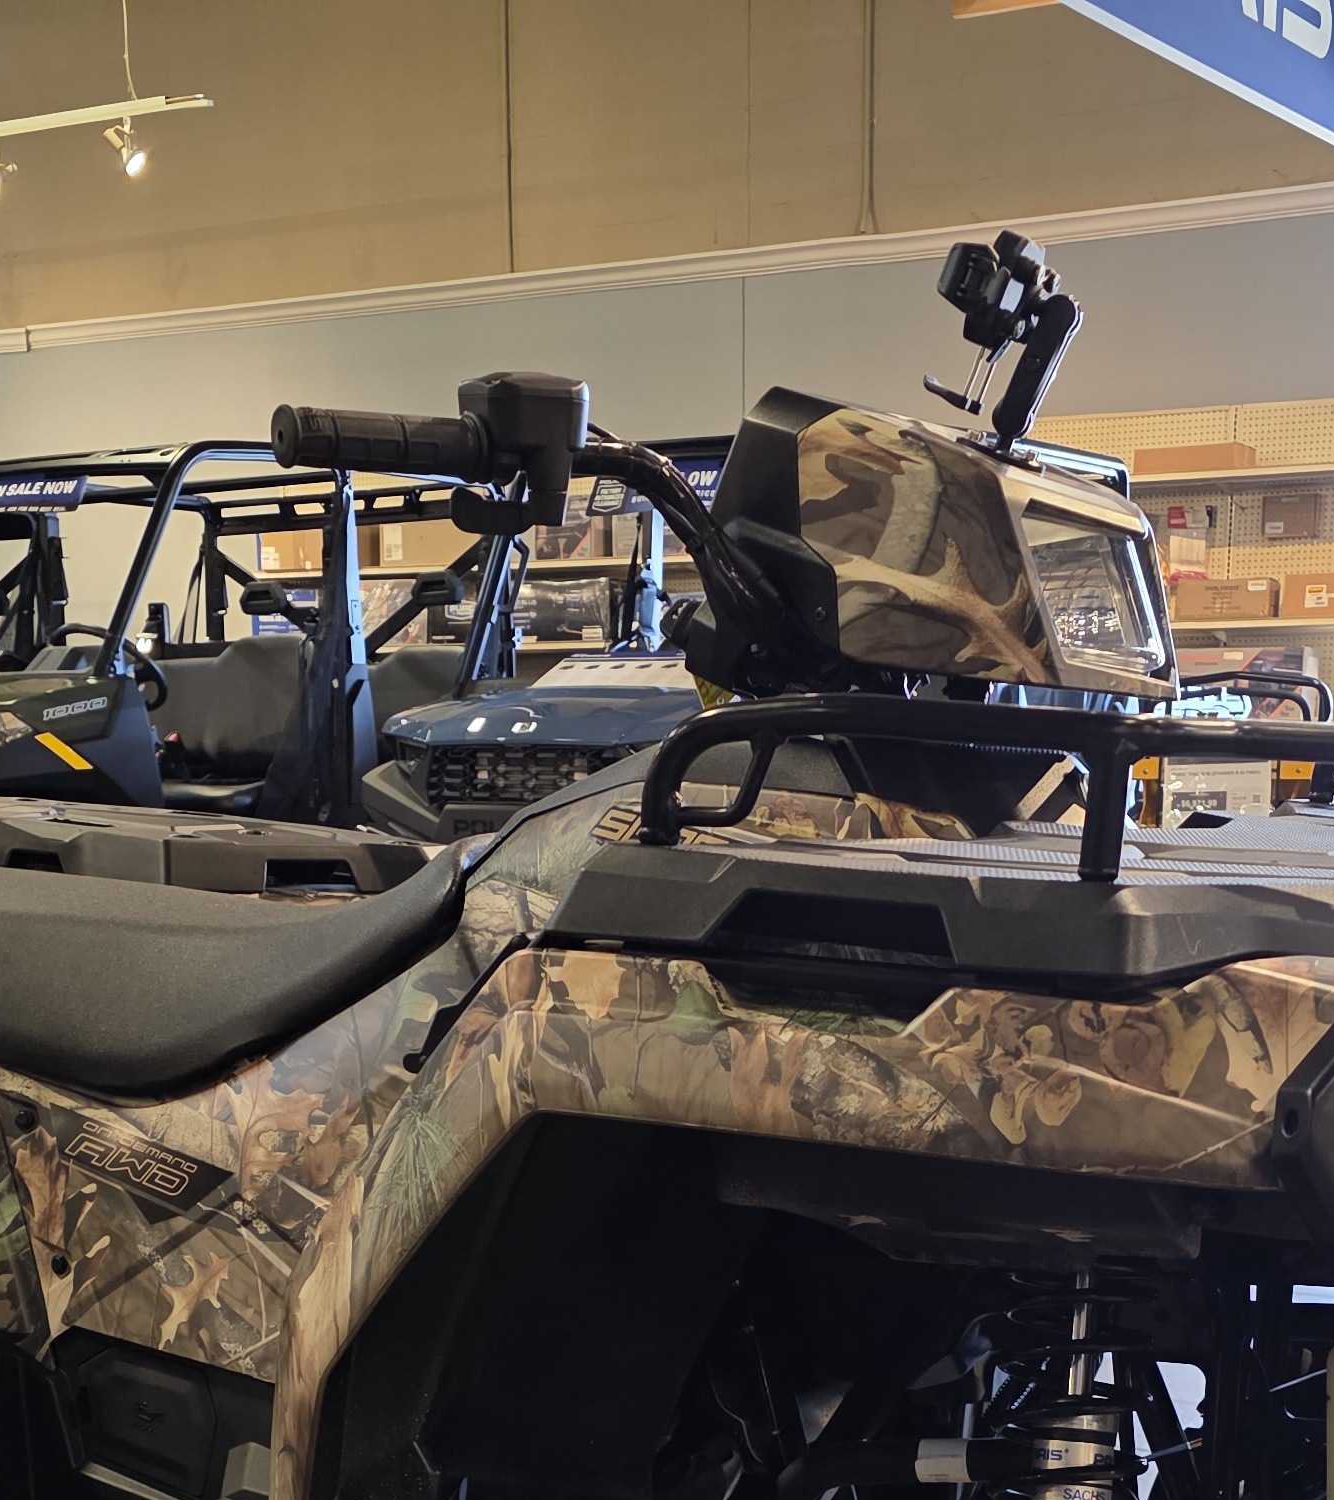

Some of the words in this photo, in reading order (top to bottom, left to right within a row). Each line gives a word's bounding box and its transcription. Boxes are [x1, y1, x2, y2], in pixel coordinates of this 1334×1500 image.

[6, 481, 44, 496] SALE
[42, 480, 78, 494] NOW
[64, 1133, 189, 1196] AWD
